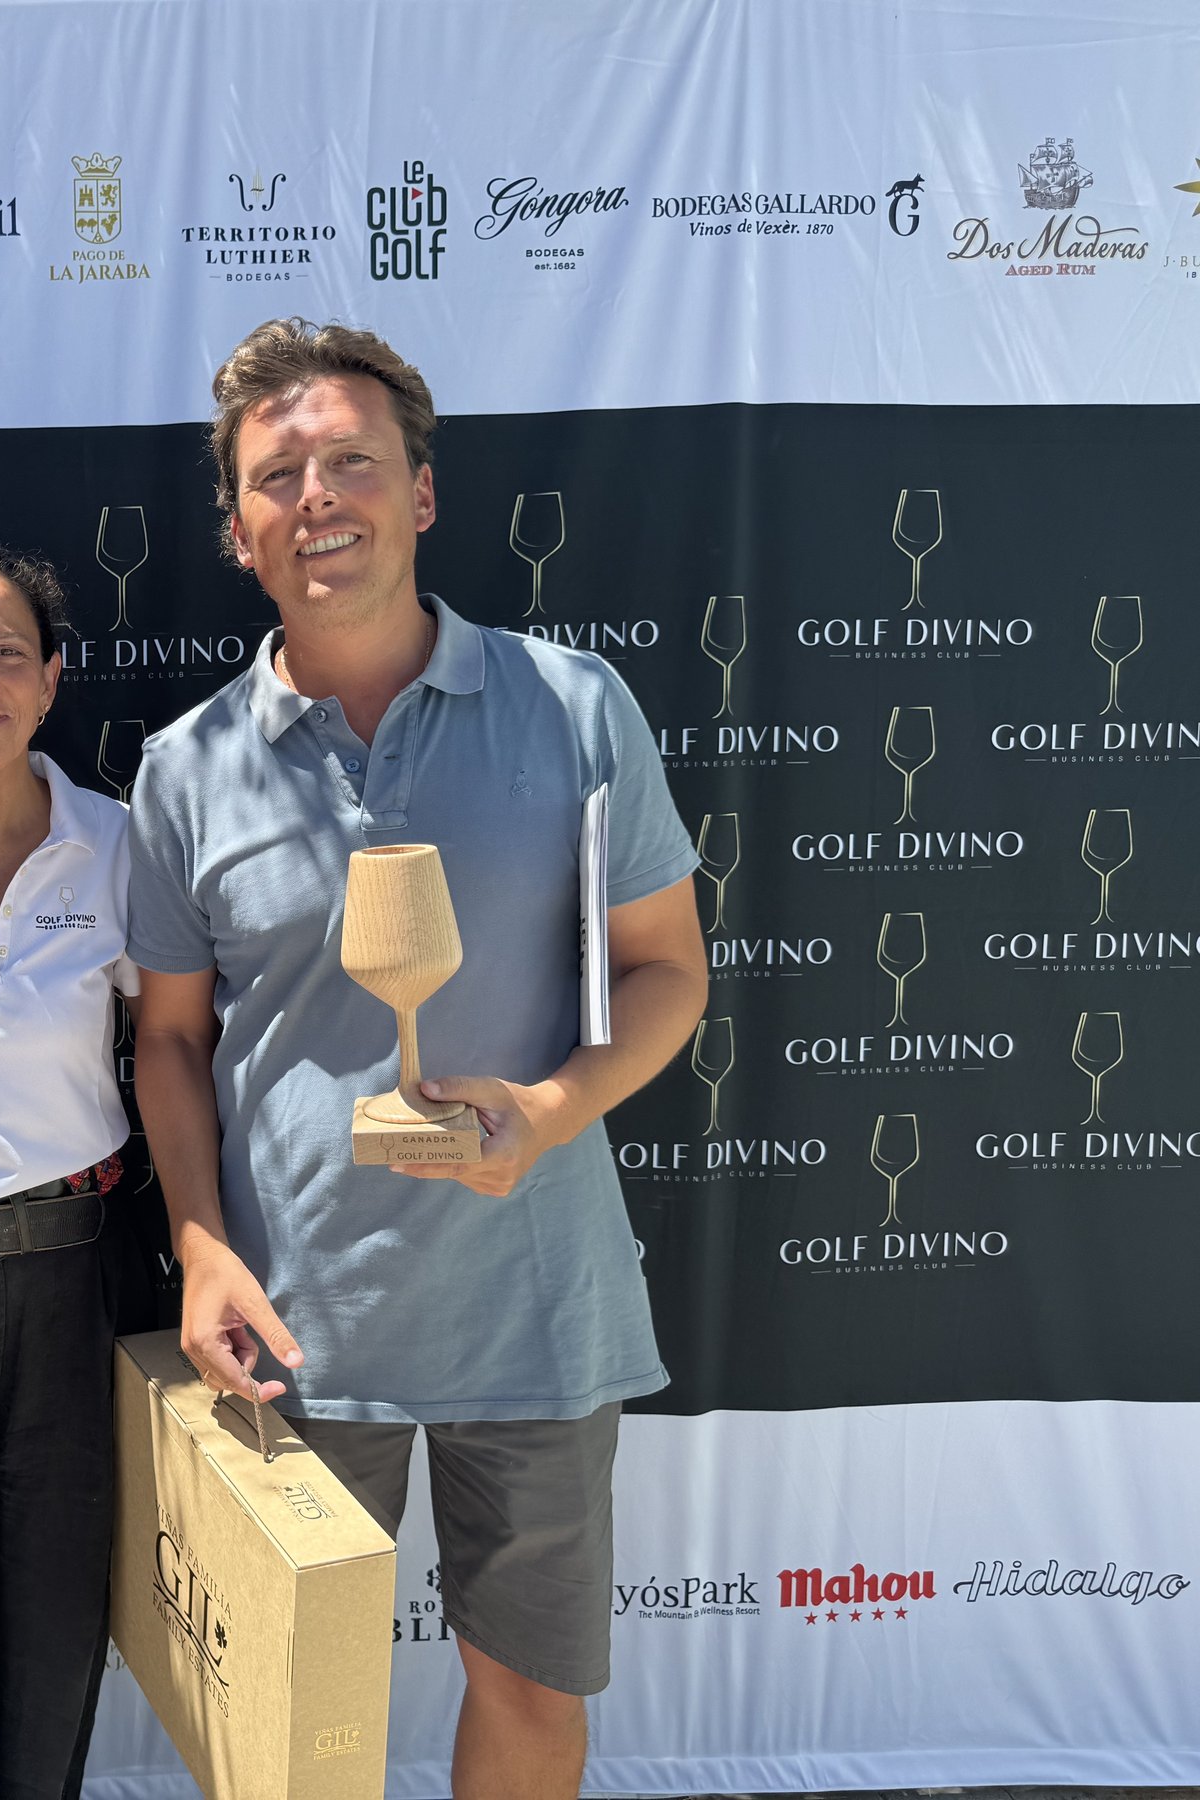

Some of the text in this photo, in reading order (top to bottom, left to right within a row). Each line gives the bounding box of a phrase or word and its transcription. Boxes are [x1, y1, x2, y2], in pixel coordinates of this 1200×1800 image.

[474, 176, 630, 241] Góngora
[181, 225, 336, 243] TERRITORIO
[689, 218, 834, 237] Vinos de Vexèr. 1870
[946, 213, 1149, 260] Dos Maderas
[72, 249, 125, 261] PAGO DE
[206, 249, 312, 265] LUTHIER
[525, 248, 585, 258] BODEGAS
[49, 263, 151, 285] LA JARABA
[534, 262, 576, 271] est. 1682
[226, 272, 291, 282] BODEGAS
[797, 618, 1033, 646] GOLF DIVINO
[115, 635, 245, 667] DIVINO
[855, 651, 970, 659] BUSINESS CLUB
[63, 671, 184, 682] BUSINESS CLUB
[718, 725, 839, 754] DIVINO
[991, 722, 1200, 751] GOLF DIVIN
[740, 759, 777, 767] CLUB
[1051, 754, 1170, 763] BUSINESS CLUB
[792, 831, 1024, 861] GOLF DIVINO
[849, 863, 963, 872] BUSINESS CLUB
[35, 914, 96, 925] GOLF DIVINO
[712, 938, 832, 968] DIVINO
[984, 932, 1200, 960] GOLF DIVIN
[734, 970, 770, 978] CLUB
[1042, 964, 1115, 972] BUSINESS
[785, 1033, 1014, 1065] GOLF DIVINO
[841, 1065, 954, 1075] BUSINESS CLUB
[402, 1136, 456, 1144] GANADOR
[975, 1132, 1067, 1159] GOLF
[397, 1152, 464, 1161] GOLF DIVINO
[619, 1138, 826, 1169] OLF DIVINO
[1032, 1162, 1106, 1170] BUSINESS
[653, 1170, 765, 1183] BUSINESS CLUB
[779, 1231, 1008, 1265] GOLF DIVINO
[835, 1262, 947, 1274] BUSINESS CLUB
[186, 1544, 233, 1622] FAMILIA
[776, 1563, 937, 1608] Mahou
[952, 1559, 1191, 1606] Hidalgo
[156, 1530, 223, 1668] GIL
[614, 1571, 761, 1616] yósPark
[638, 1610, 652, 1619] The
[654, 1610, 693, 1620] Mountain
[700, 1607, 734, 1616] Wellness
[735, 1606, 761, 1615] Resort
[152, 1590, 230, 1718] FAMILY ESTATES
[315, 1729, 358, 1751] GIL
